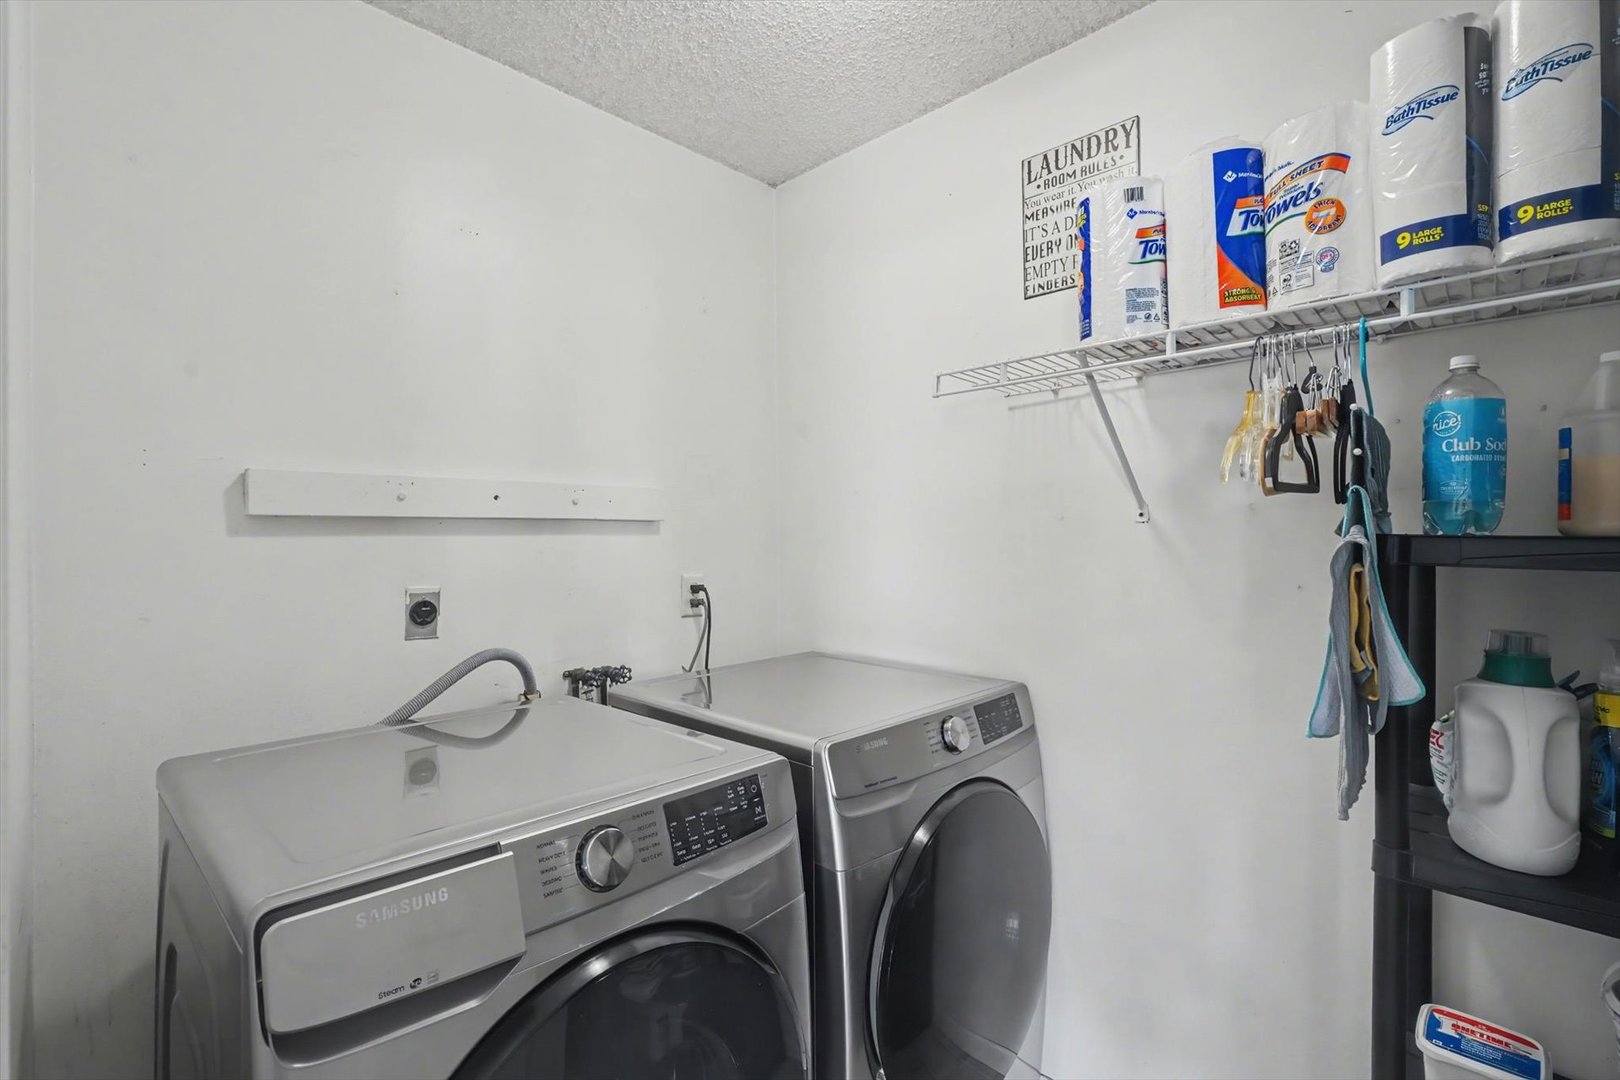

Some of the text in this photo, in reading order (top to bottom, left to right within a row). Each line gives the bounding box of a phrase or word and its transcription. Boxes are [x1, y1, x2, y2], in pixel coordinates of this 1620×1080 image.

[1026, 119, 1136, 186] LAUNDRY
[1043, 155, 1117, 190] ROOM RULES
[1289, 160, 1325, 182] SHEET
[1024, 198, 1041, 210] You
[1043, 190, 1065, 204] wear
[1265, 181, 1323, 224] owels
[1517, 199, 1572, 225] 9 LARGE
[1024, 223, 1049, 243] IT'S
[1051, 220, 1061, 236] A
[1396, 227, 1442, 250] 9 LARGE
[1025, 237, 1062, 263] EVERY
[1024, 256, 1069, 282] EMPTY
[1025, 273, 1076, 296] FINDERS
[1442, 436, 1481, 453] Club
[355, 887, 449, 929] SAMSUNG
[378, 985, 405, 1000] Steam
